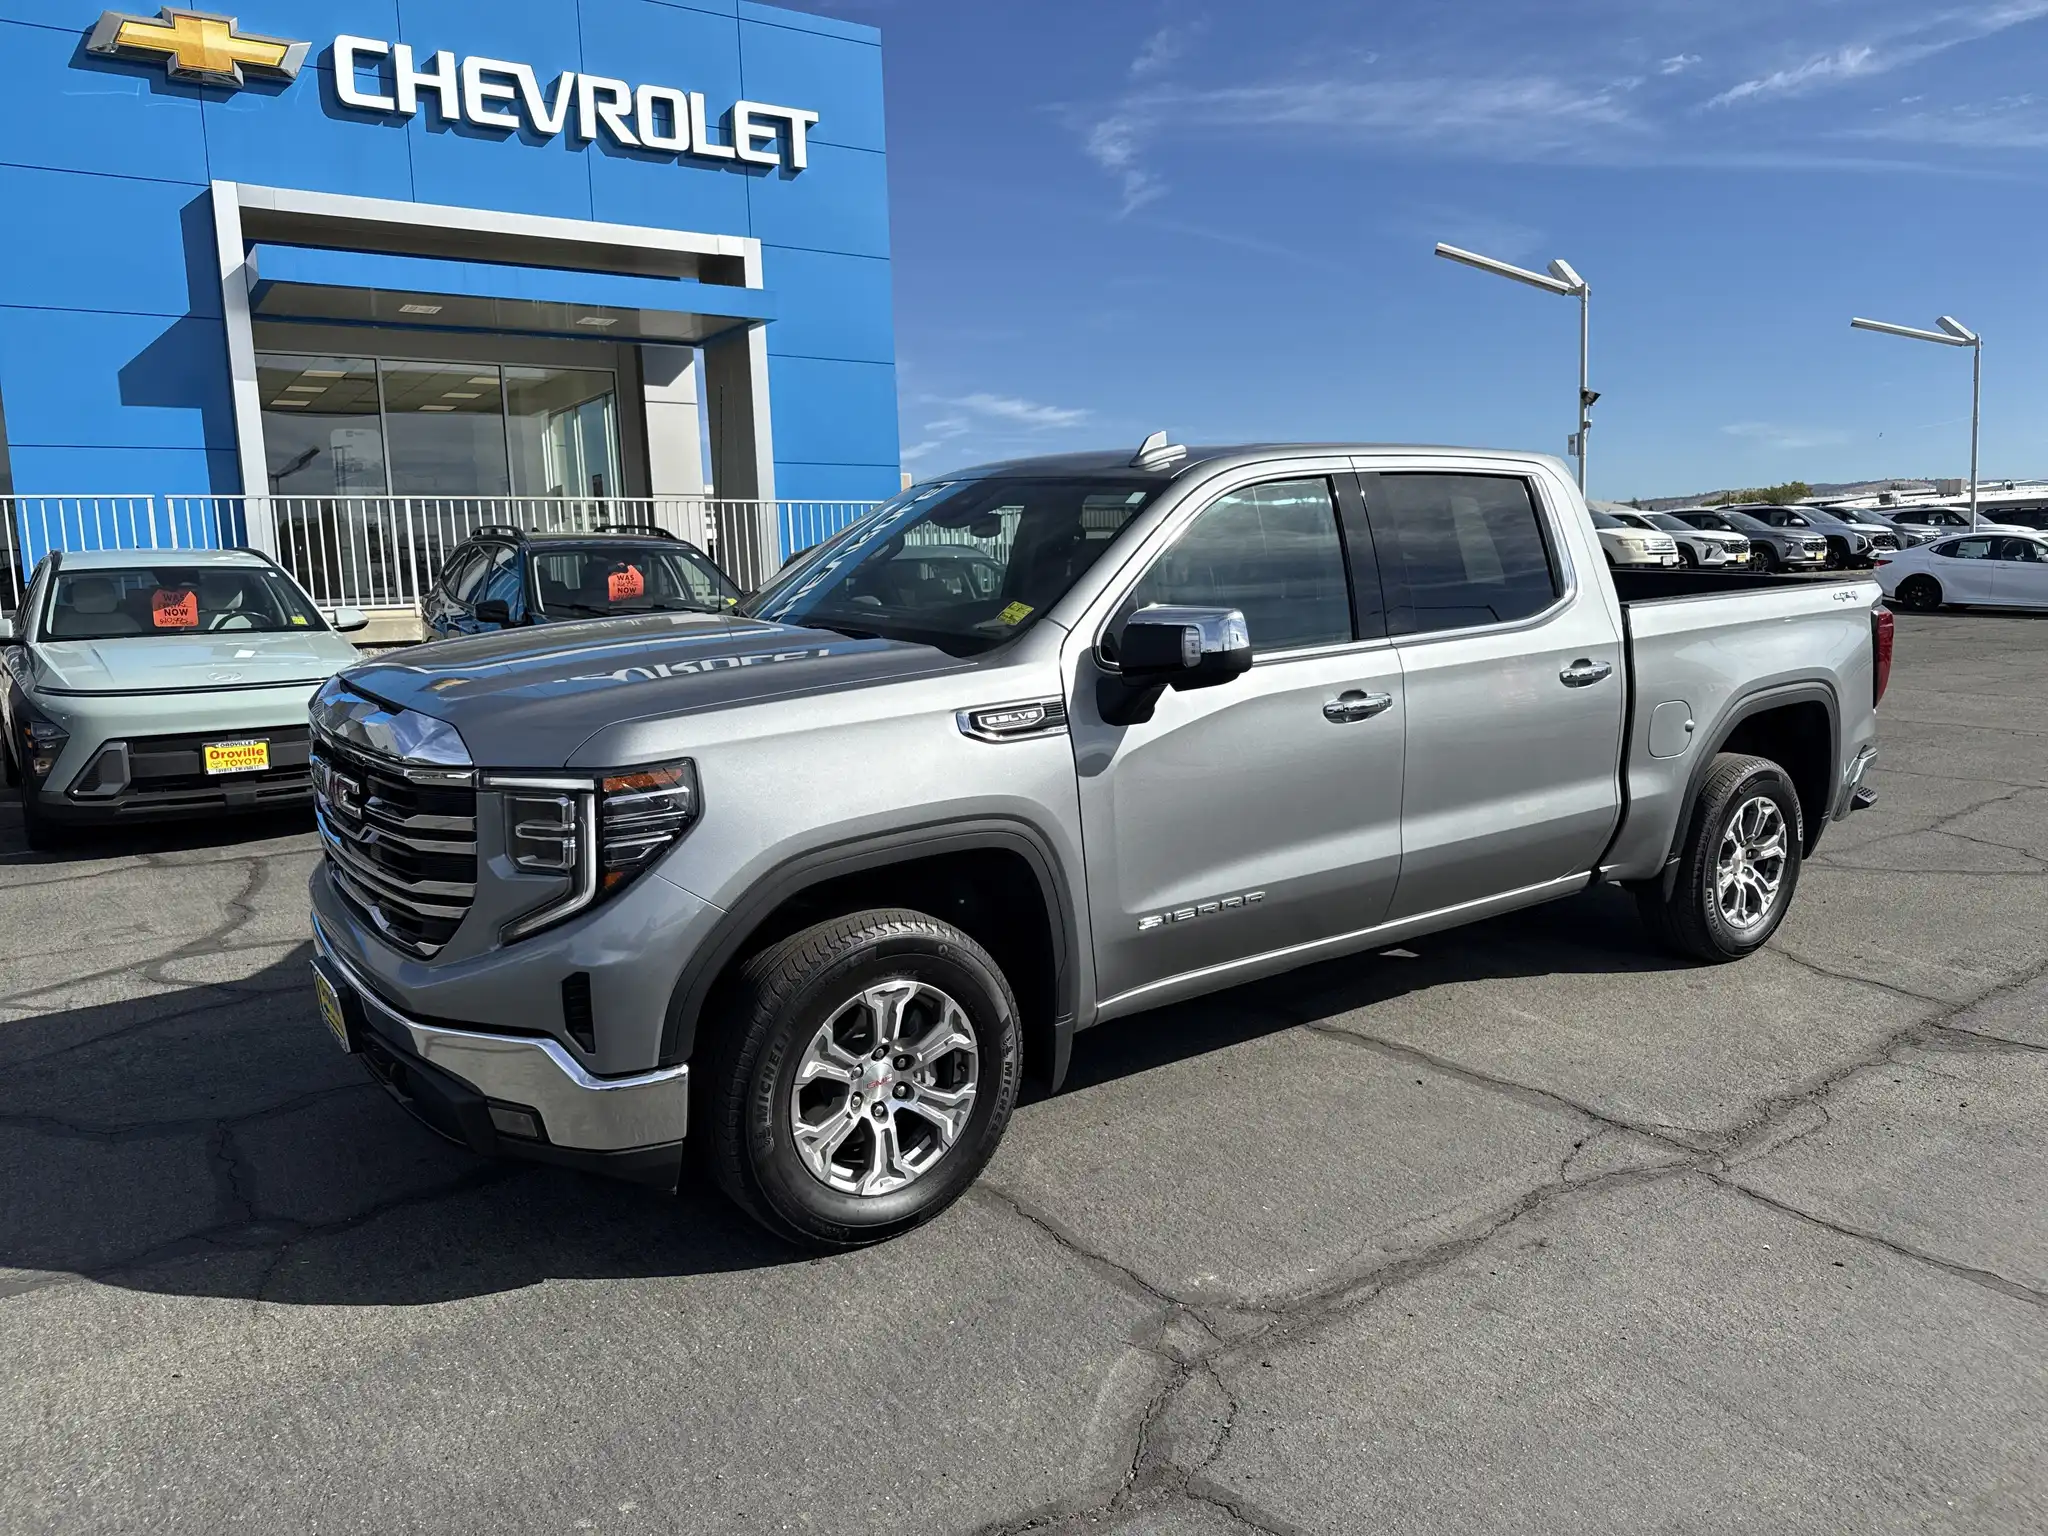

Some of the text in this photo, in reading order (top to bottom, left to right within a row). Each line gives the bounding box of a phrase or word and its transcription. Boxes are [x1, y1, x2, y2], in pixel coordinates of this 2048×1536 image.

[333, 34, 820, 171] CHEVROLET
[163, 593, 185, 601] WAS
[164, 608, 188, 617] NOW
[210, 747, 265, 760] Oroville
[224, 757, 265, 767] TOYOTA
[1138, 891, 1266, 931] SIERRA
